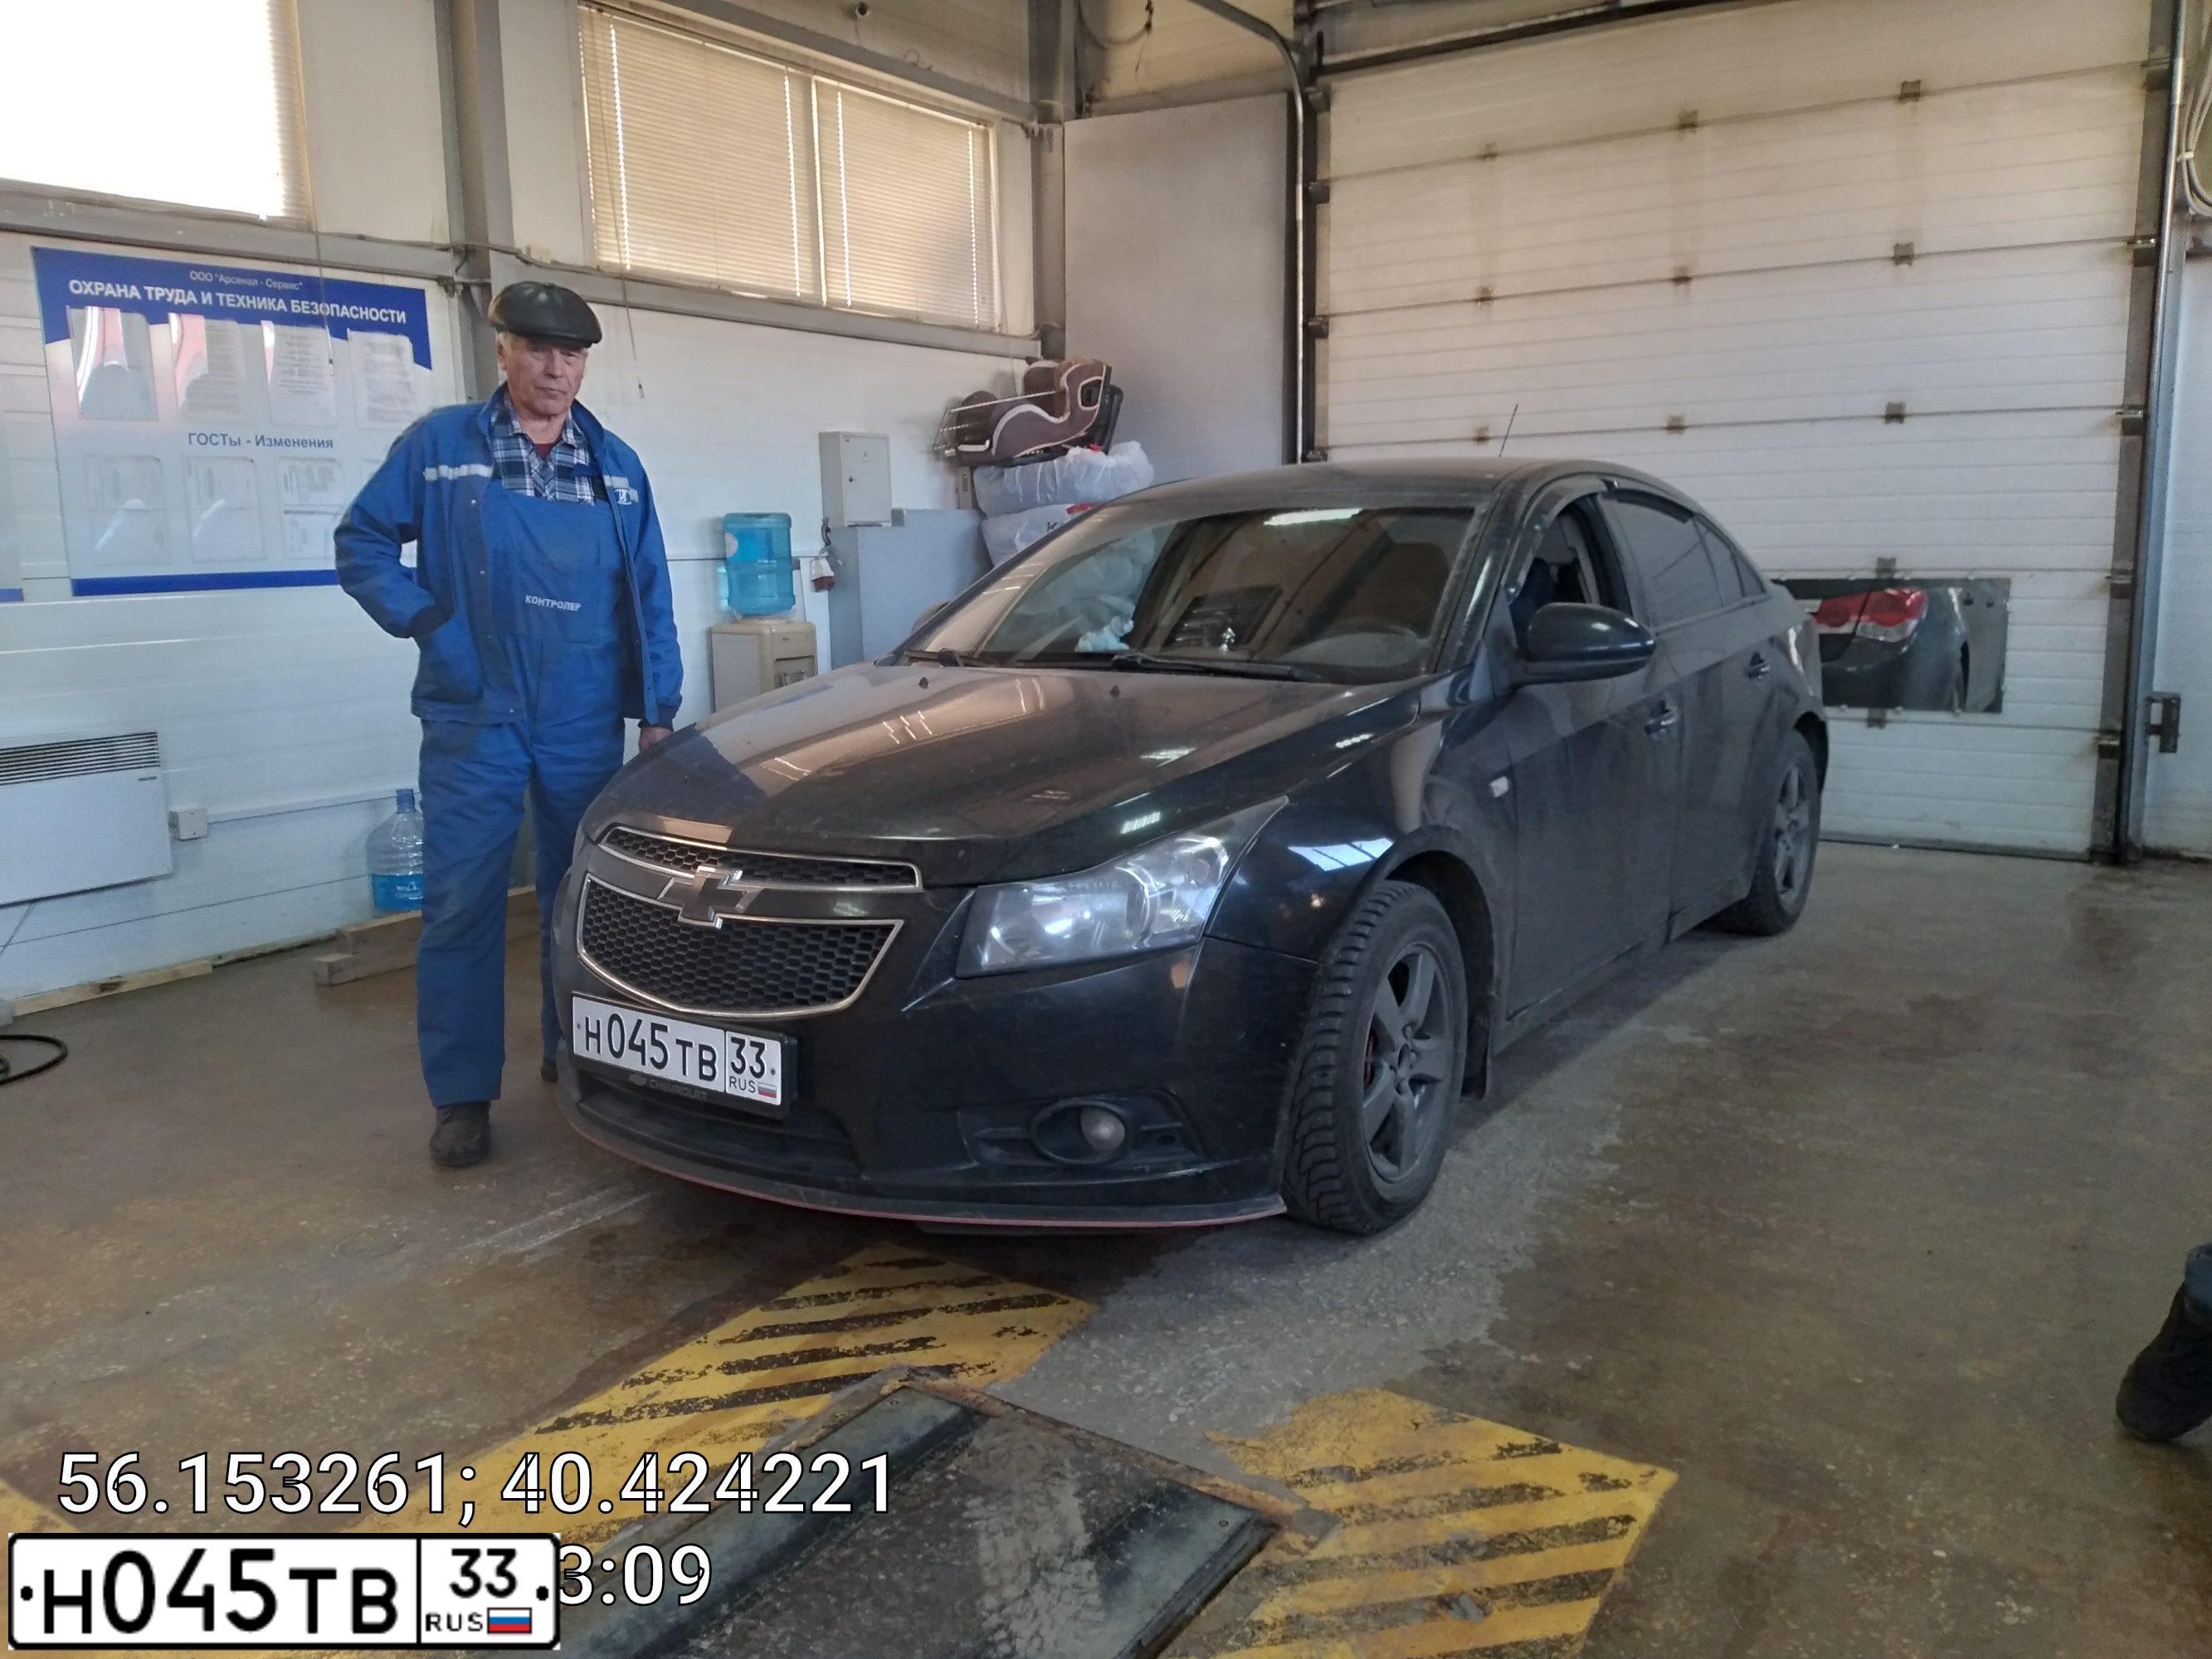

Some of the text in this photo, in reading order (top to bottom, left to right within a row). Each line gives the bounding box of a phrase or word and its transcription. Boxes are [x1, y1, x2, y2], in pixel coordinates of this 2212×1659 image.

[189, 270, 213, 282] ООО
[68, 279, 407, 324] ОХРАНА ТРУДА И ТЕХНИКА БЕЗОПАСНОСТИ
[188, 431, 241, 447] ГОСТы
[255, 434, 334, 449] Изменения
[524, 594, 581, 611] КОНТРОЛЕР
[730, 1036, 766, 1079] 33
[728, 1076, 756, 1093] RUS
